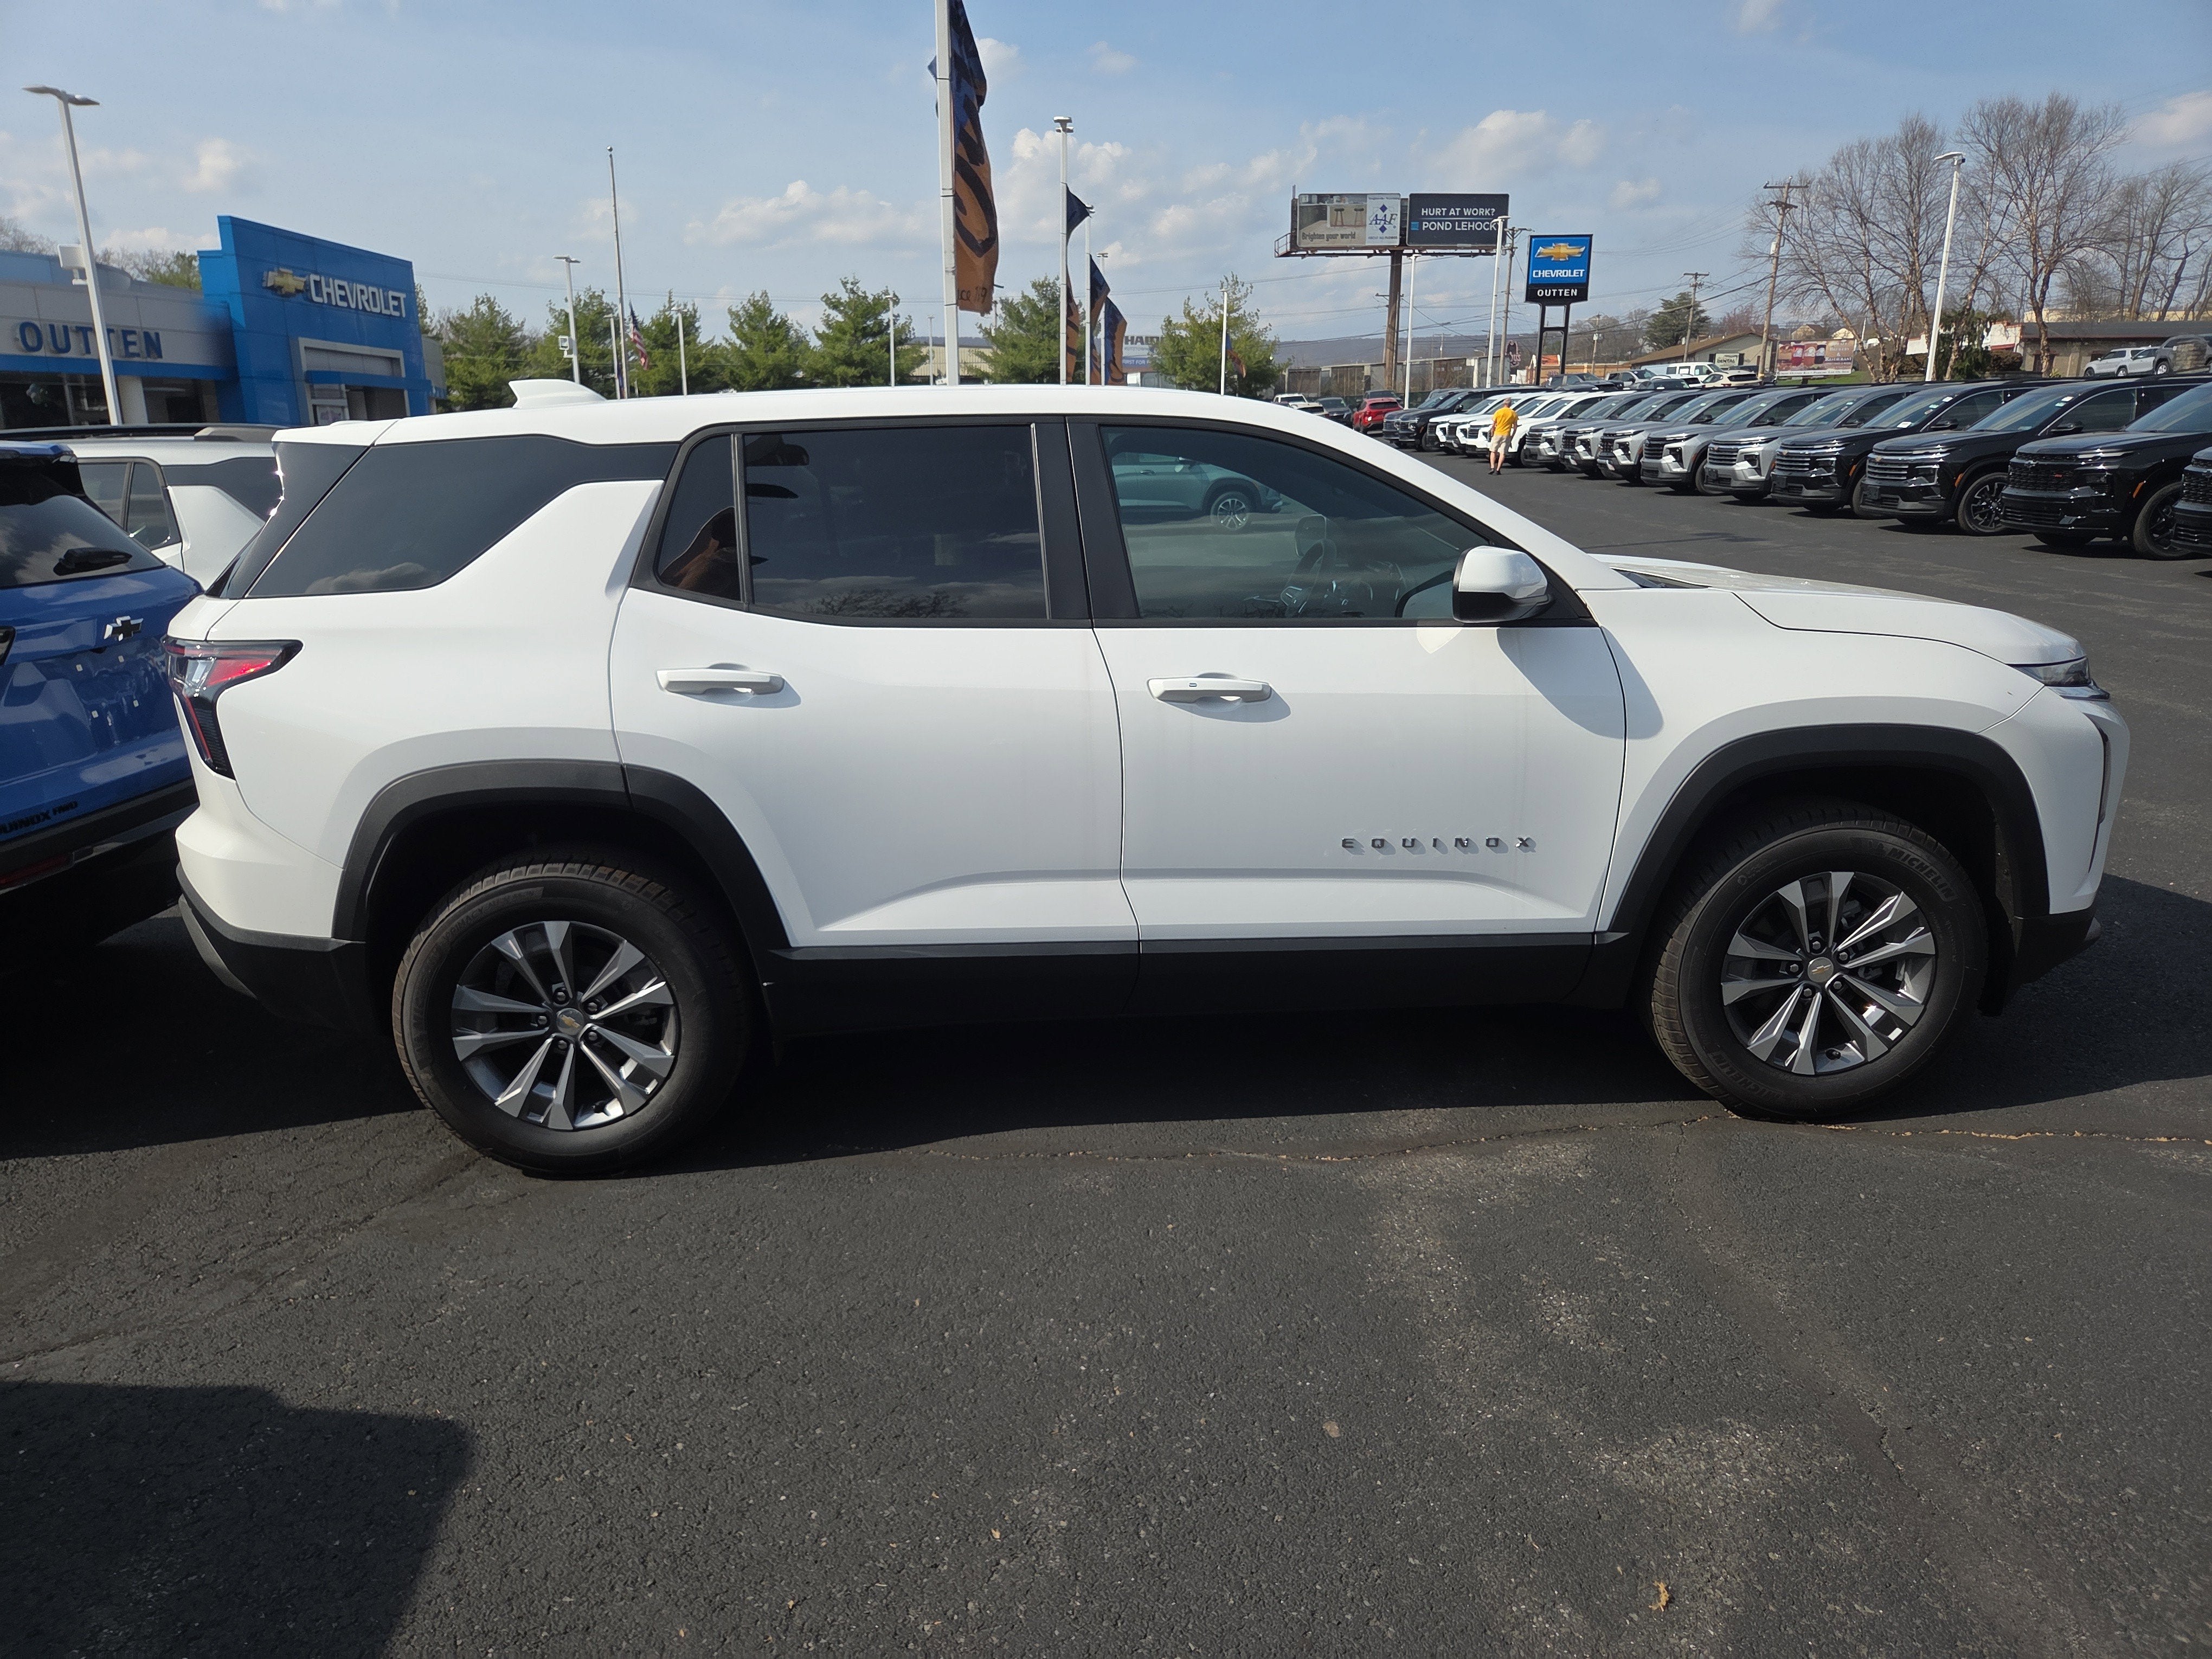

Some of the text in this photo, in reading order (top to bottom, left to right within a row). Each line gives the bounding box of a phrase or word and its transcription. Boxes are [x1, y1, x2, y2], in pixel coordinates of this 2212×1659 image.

[1422, 222, 1497, 230] POND LEHOCK
[1533, 269, 1585, 278] CHEVROLET
[310, 274, 407, 318] CHEVROLET
[1537, 288, 1577, 297] OUTTEN
[1341, 837, 1530, 848] EQUINOX
[1887, 847, 1954, 899] MICHELIN
